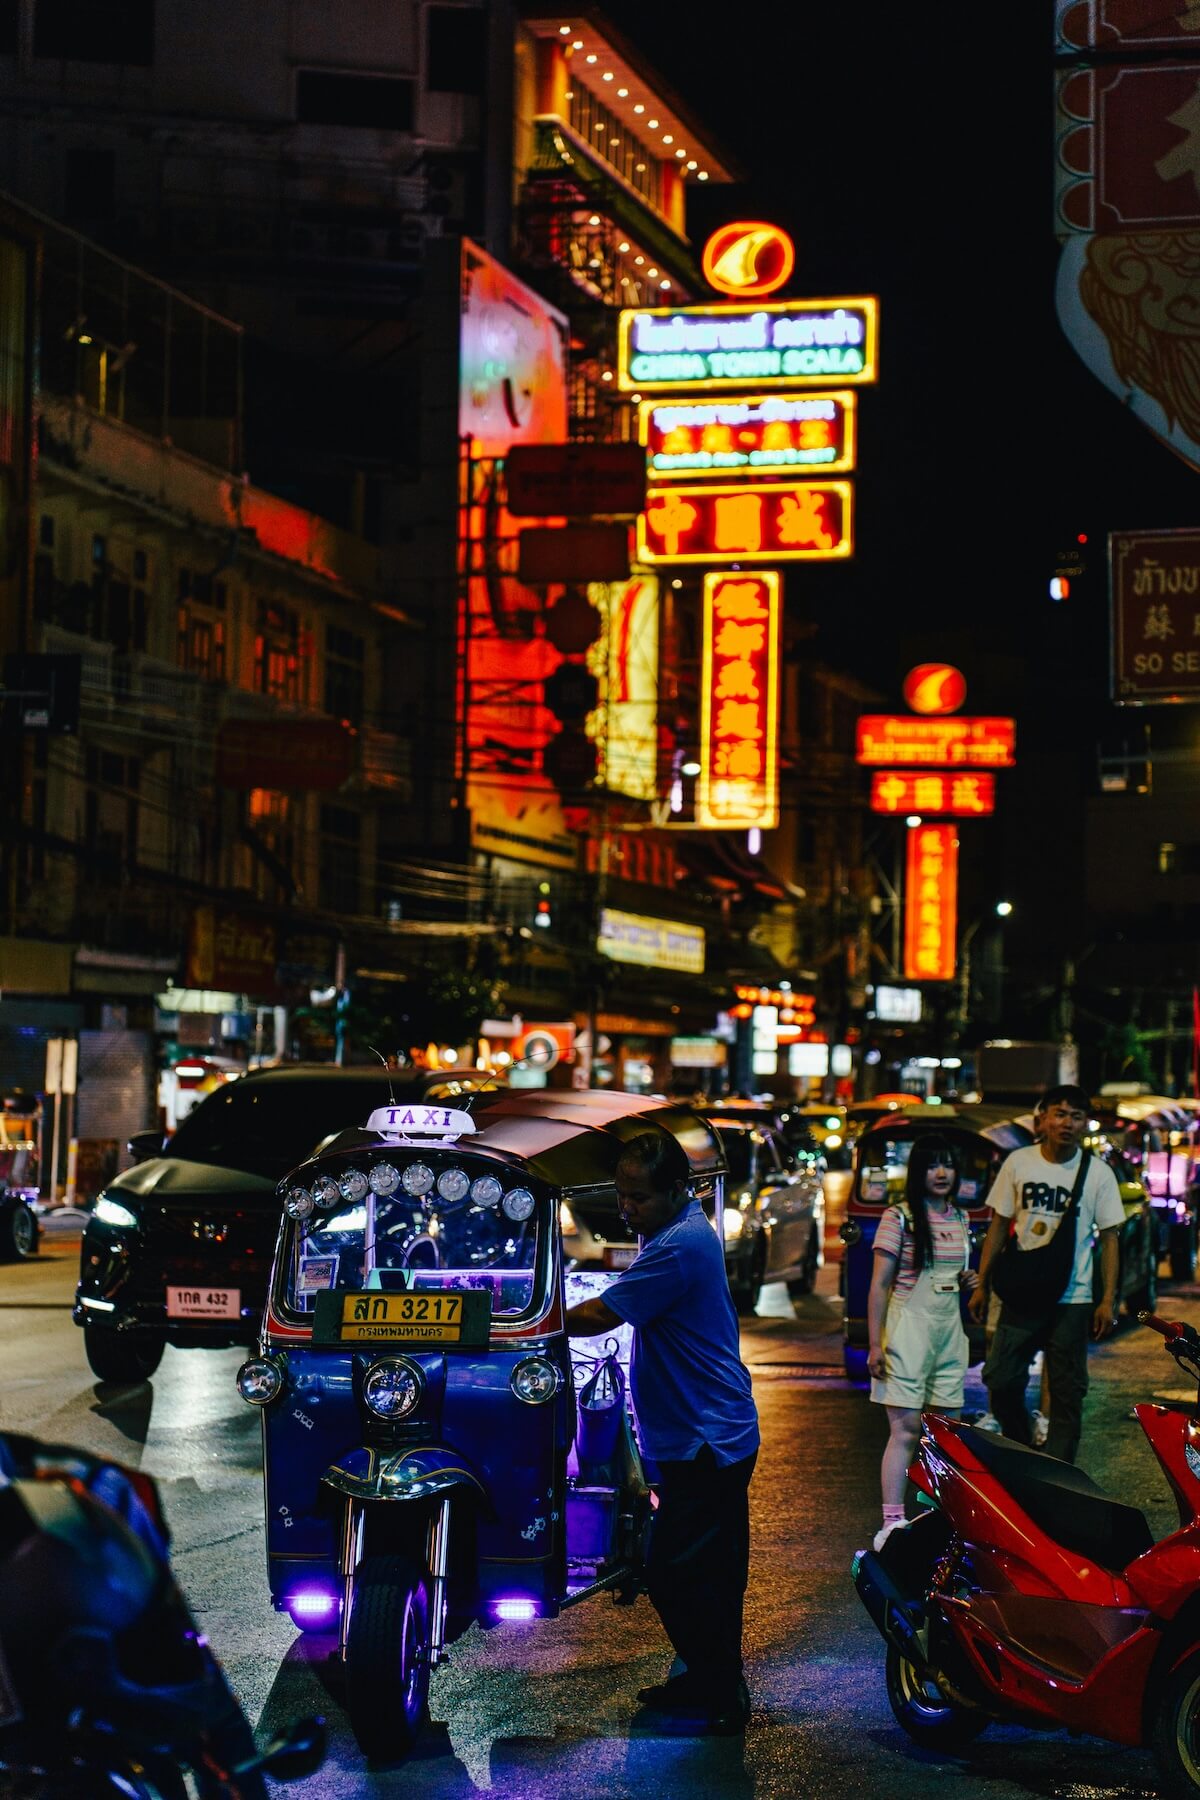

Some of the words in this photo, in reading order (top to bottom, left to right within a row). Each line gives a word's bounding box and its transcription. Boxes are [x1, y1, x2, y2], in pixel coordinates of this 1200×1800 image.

[782, 348, 863, 375] SCALA
[1134, 557, 1200, 596] ห้างข
[1134, 653, 1164, 674] SO
[386, 1109, 453, 1126] TAXI
[1022, 1182, 1080, 1217] PRID
[206, 1293, 228, 1306] 432
[354, 1296, 388, 1320] สก
[401, 1298, 460, 1320] 3217
